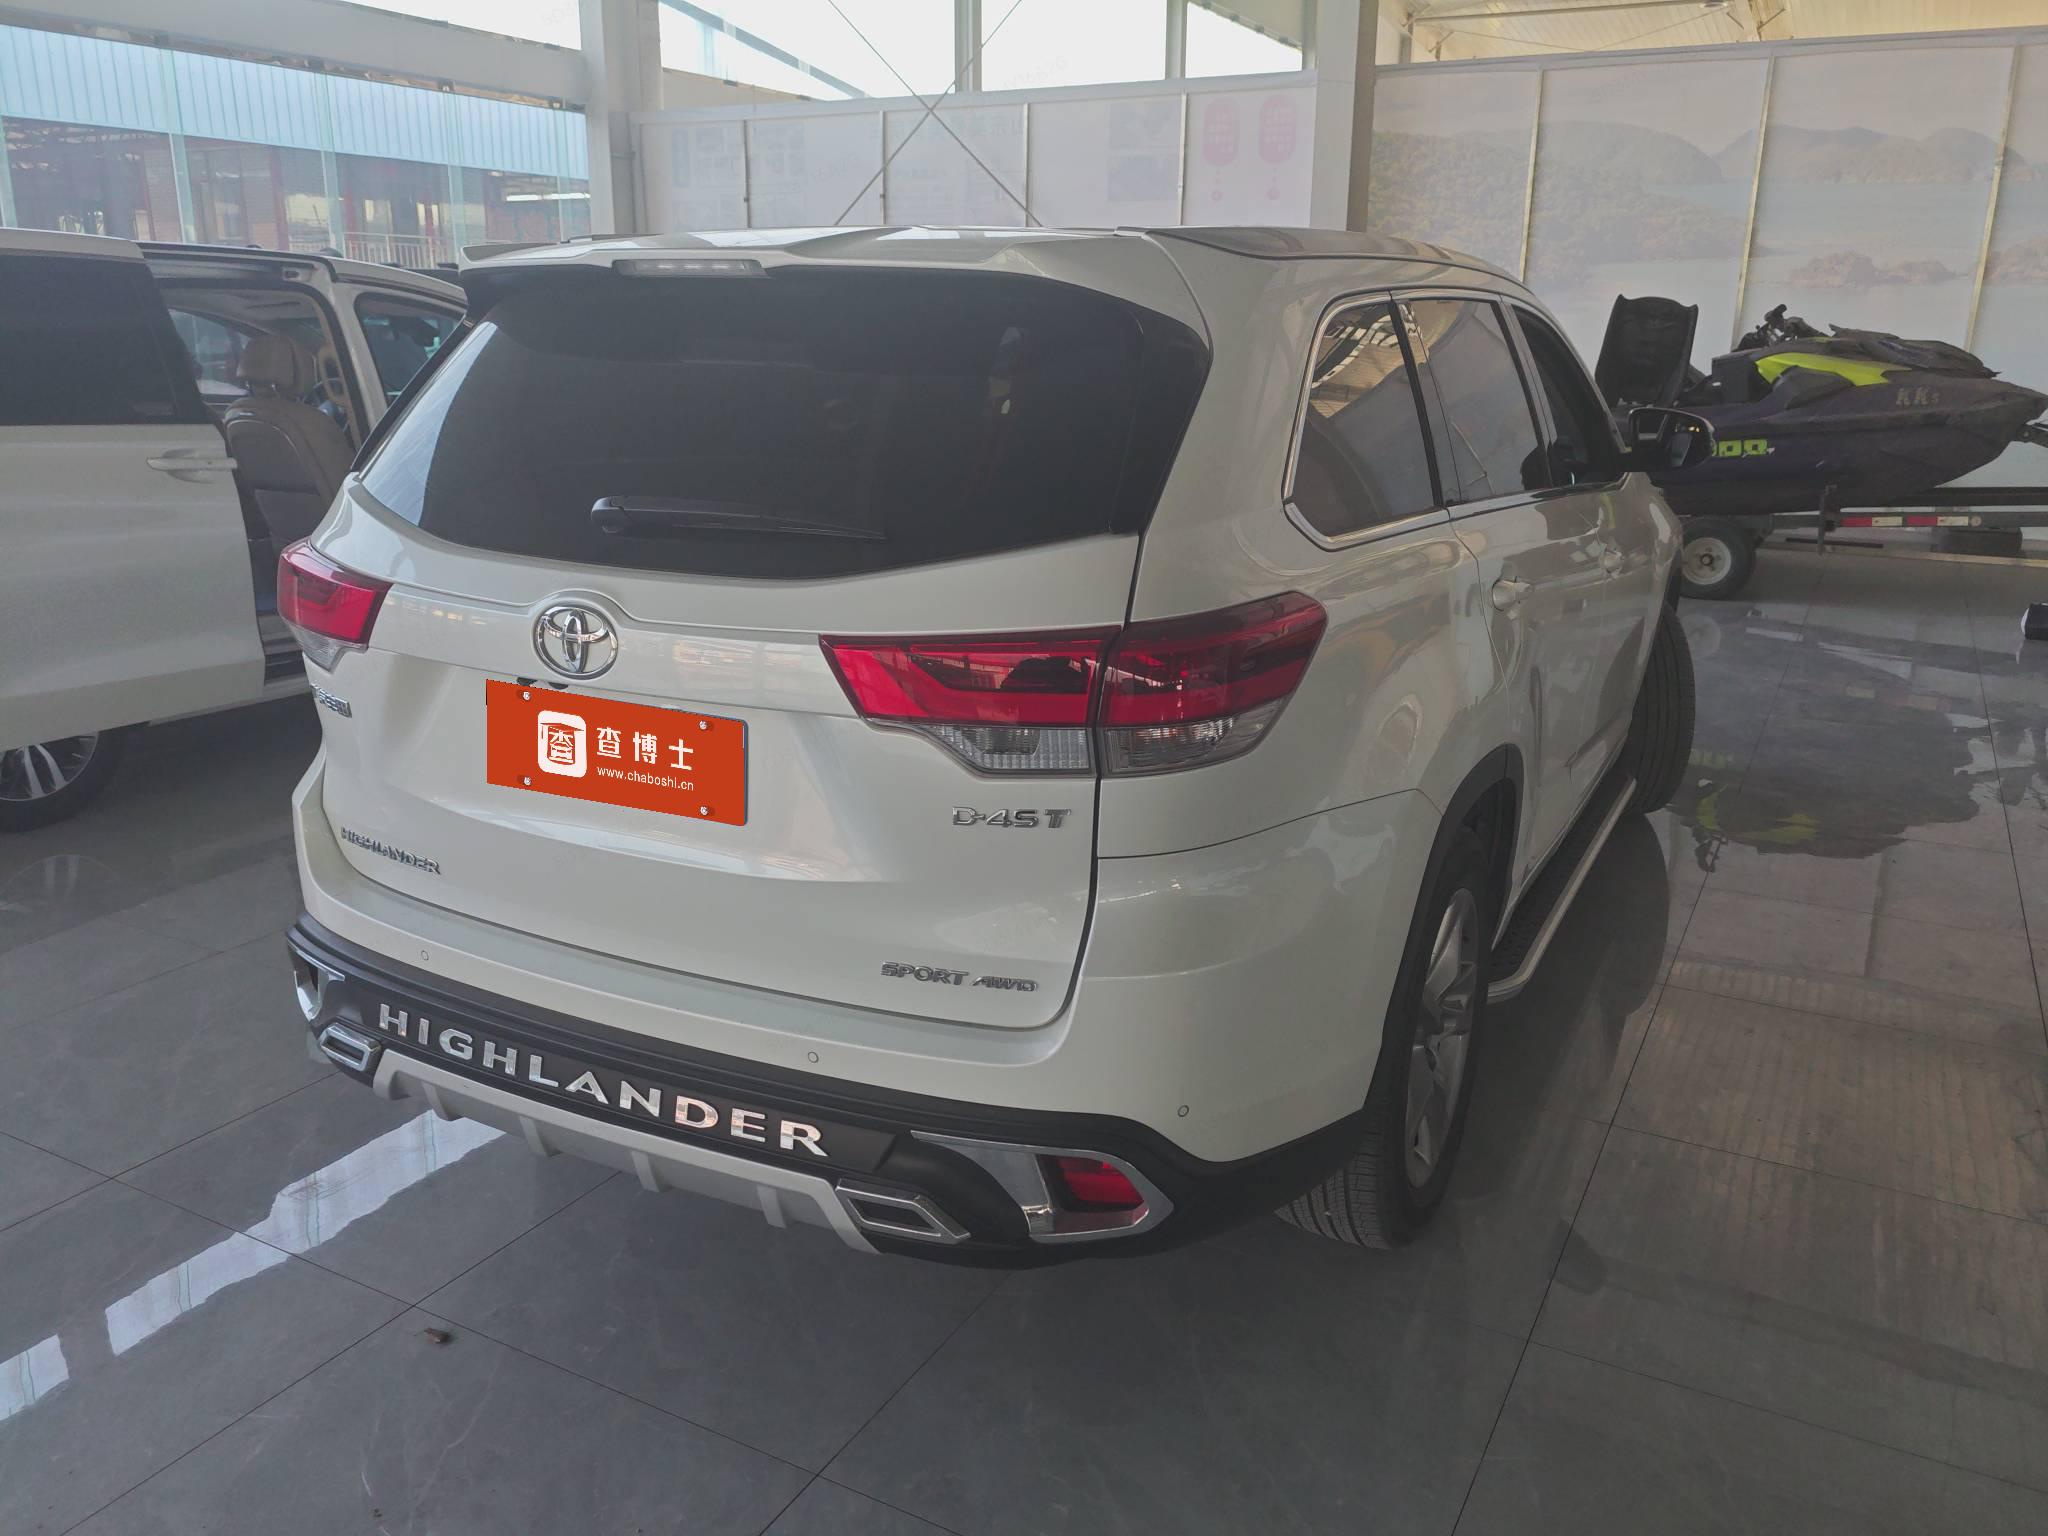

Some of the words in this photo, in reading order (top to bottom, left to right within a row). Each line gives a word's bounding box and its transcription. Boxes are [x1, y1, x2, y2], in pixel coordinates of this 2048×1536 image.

[1711, 437, 1768, 457] 00
[881, 961, 969, 986] SPORT
[971, 975, 1040, 992] AWD
[379, 1003, 828, 1157] HIGHLANDER
